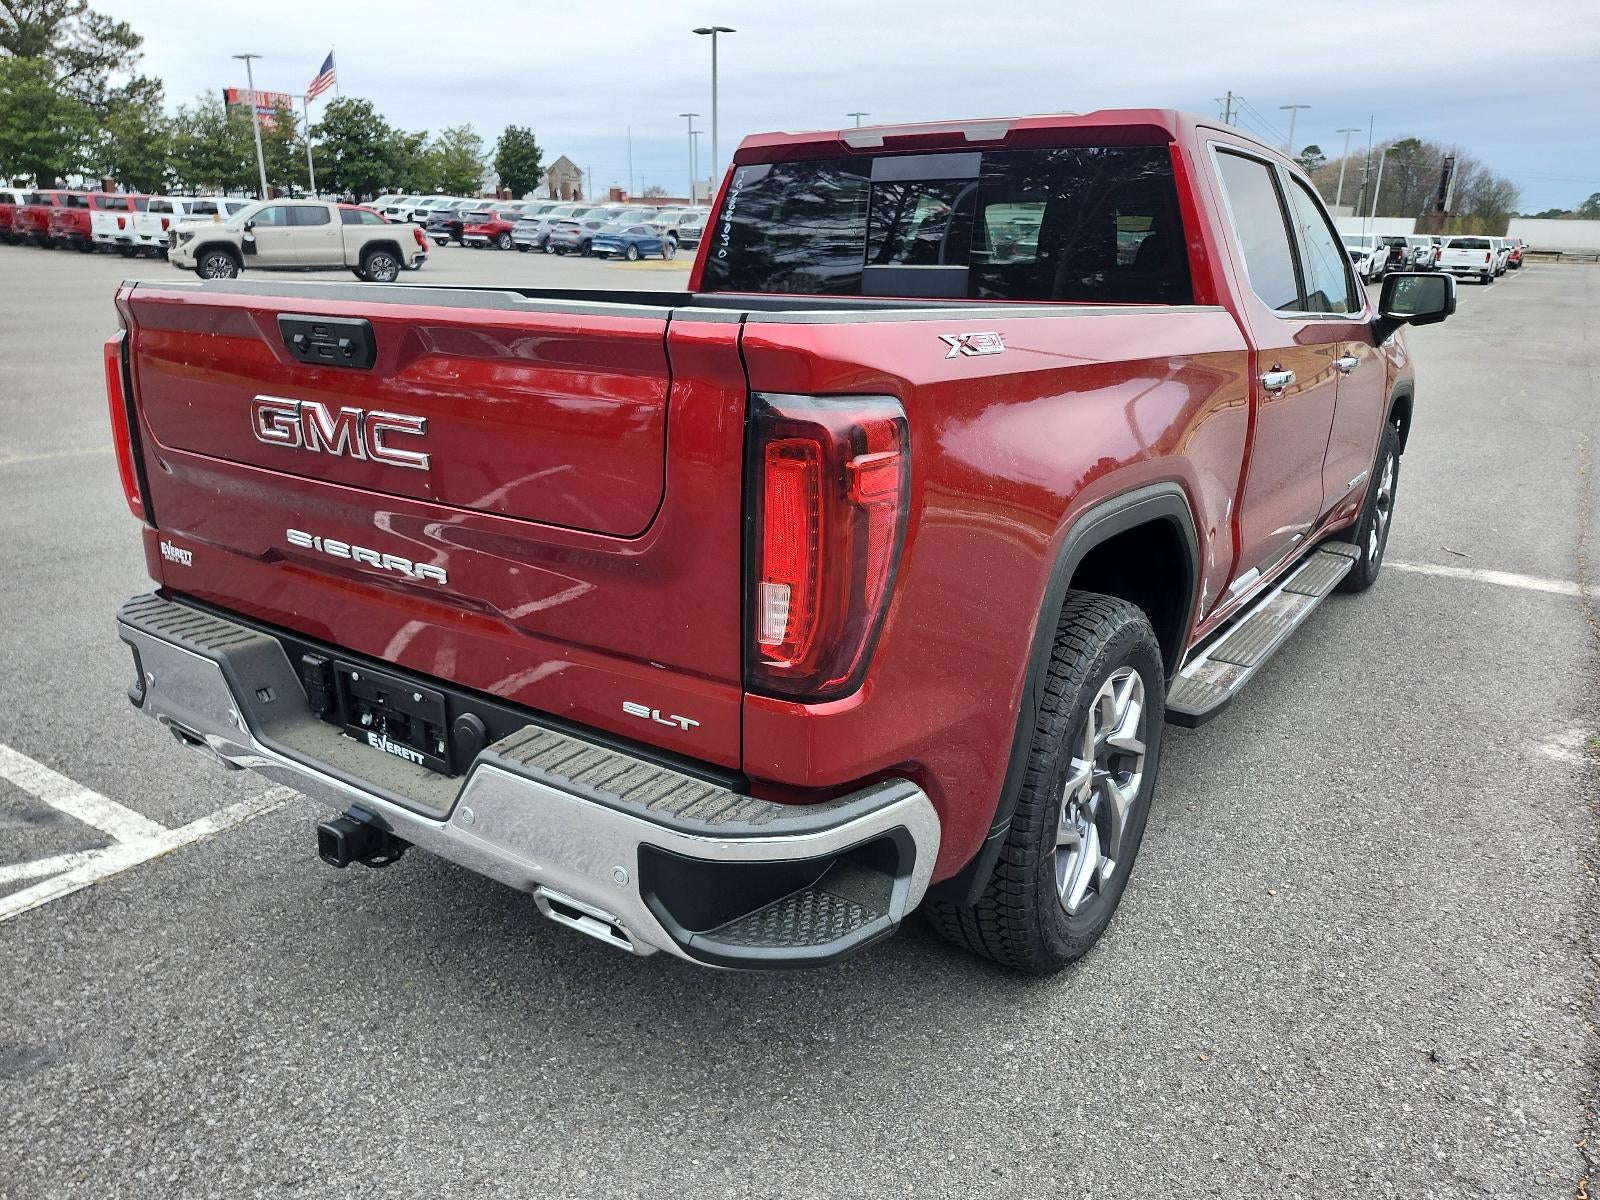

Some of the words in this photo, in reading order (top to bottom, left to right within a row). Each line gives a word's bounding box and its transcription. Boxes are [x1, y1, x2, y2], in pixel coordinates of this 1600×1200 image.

[250, 394, 431, 471] GMC
[160, 539, 193, 561] EVERETT
[285, 527, 449, 585] SIERRA
[622, 701, 700, 731] SLT
[366, 730, 425, 765] EVERETT
